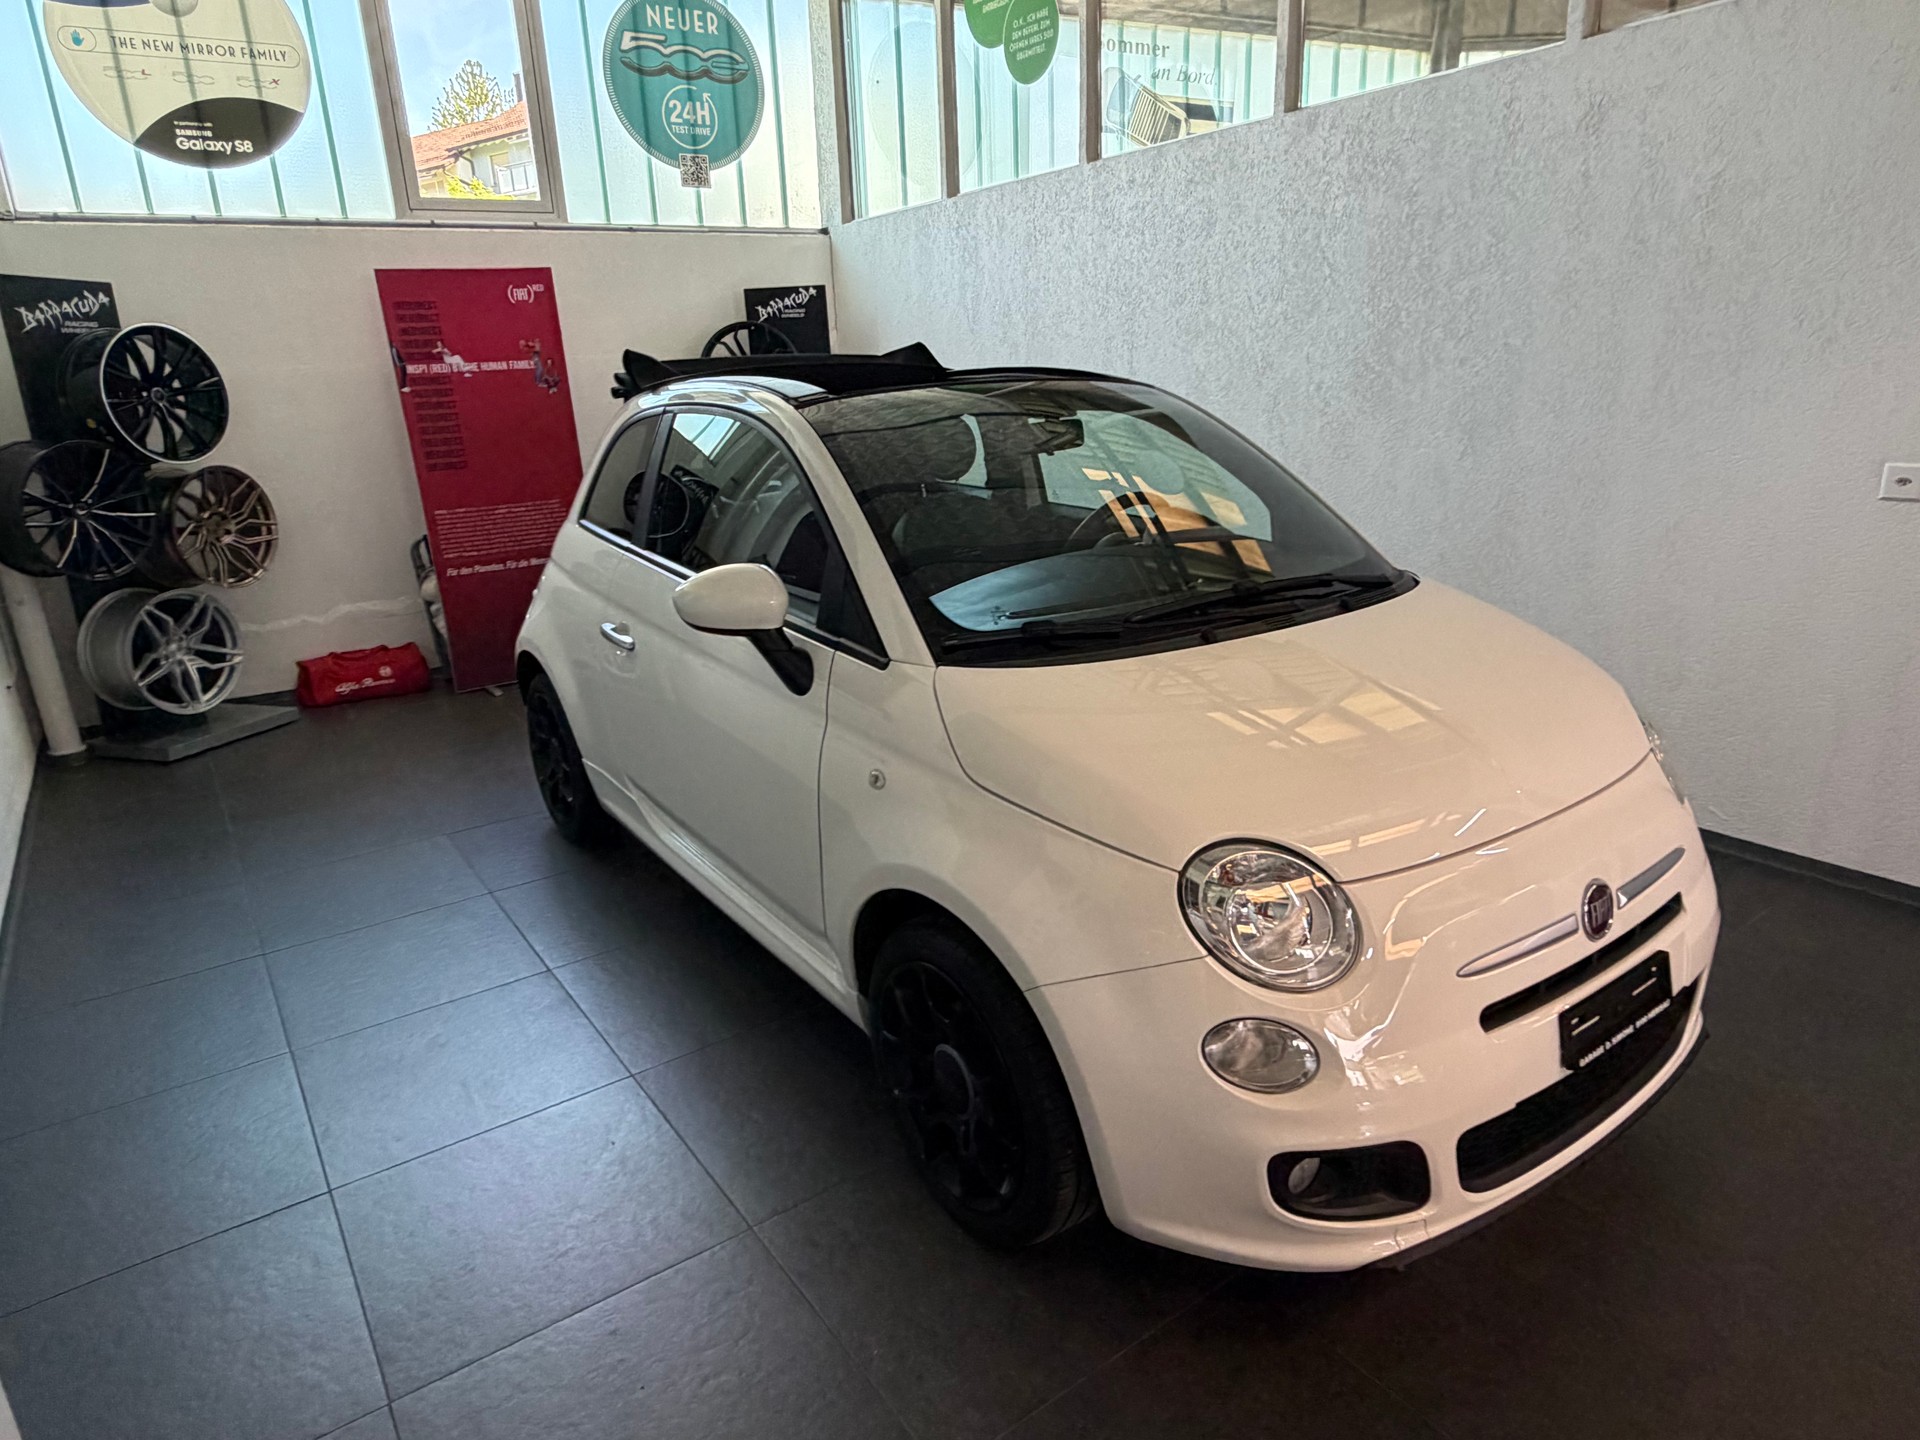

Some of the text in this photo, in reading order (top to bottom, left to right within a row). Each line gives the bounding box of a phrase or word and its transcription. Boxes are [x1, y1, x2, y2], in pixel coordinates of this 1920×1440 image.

[646, 3, 719, 35] NEUER
[110, 35, 287, 62] THE NEW MIRROR FAMILY
[1151, 67, 1171, 81] an
[669, 99, 711, 125] 24H
[175, 128, 213, 138] SAMSUNG
[671, 125, 711, 136] TEST DRIVE
[176, 136, 254, 155] Galaxy S8
[13, 290, 110, 334] BARRACUDA
[754, 286, 817, 323] BARRACUDA
